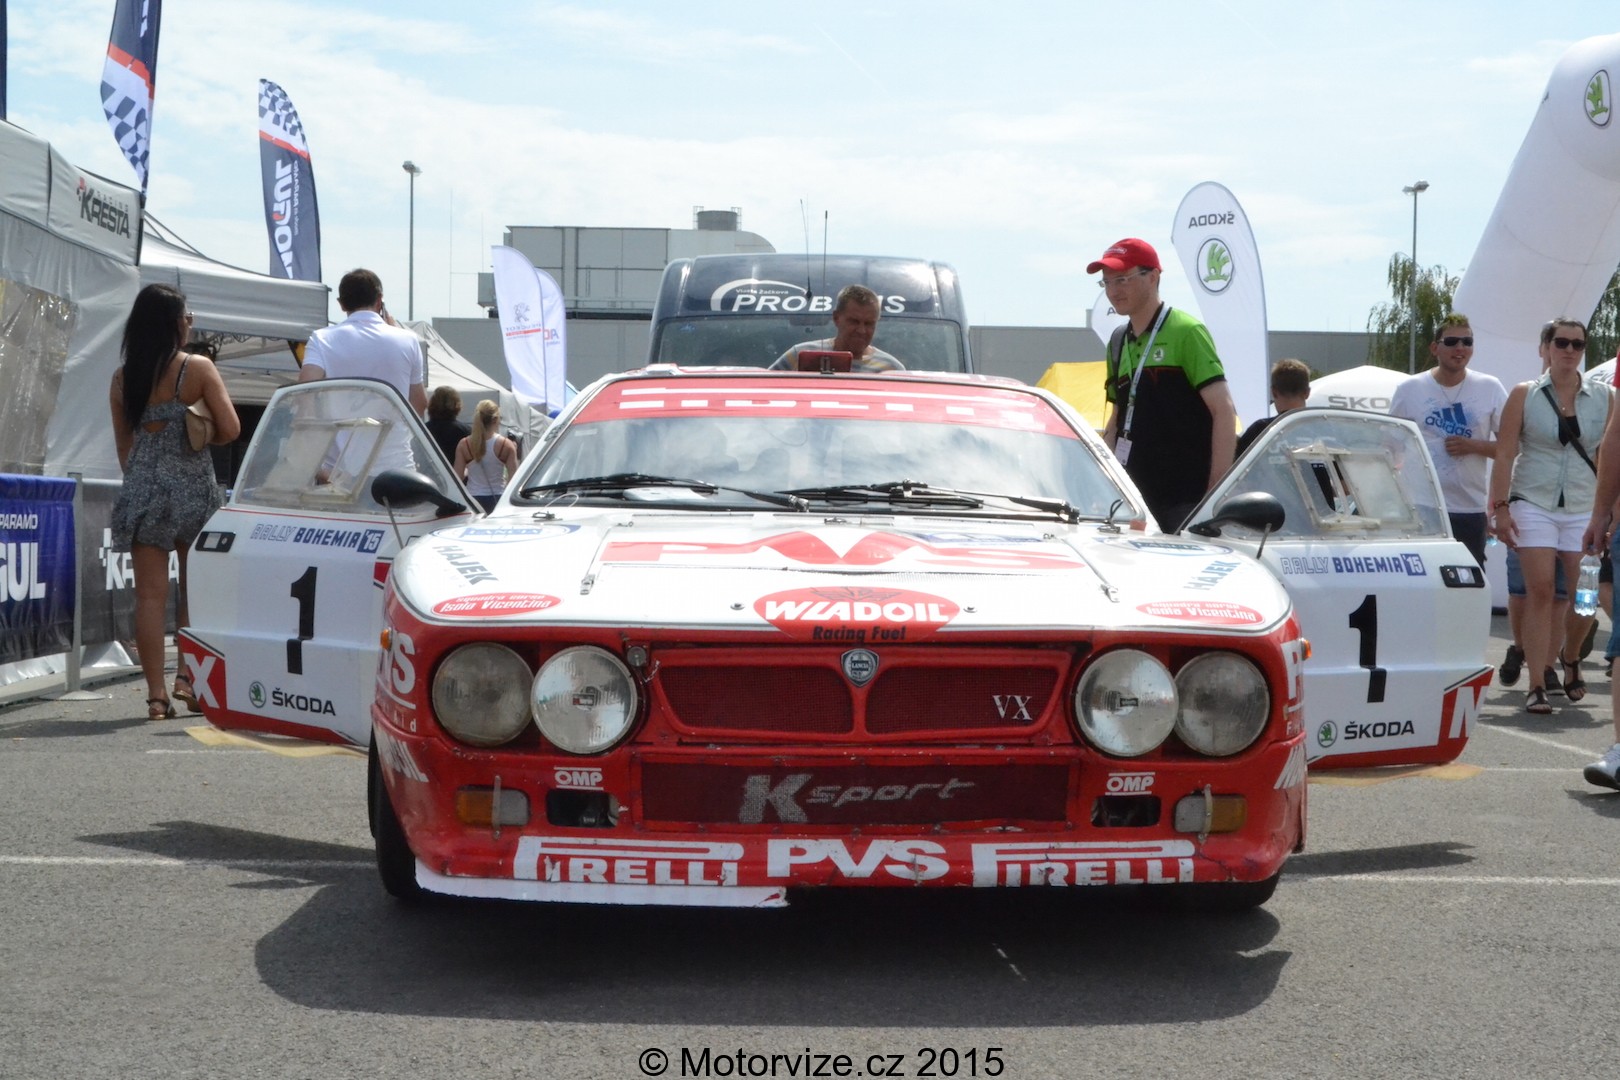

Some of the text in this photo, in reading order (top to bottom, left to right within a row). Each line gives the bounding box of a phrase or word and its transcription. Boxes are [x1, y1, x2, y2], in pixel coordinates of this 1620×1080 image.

[80, 188, 131, 239] KRESTA
[732, 295, 907, 314] PROBS
[1424, 414, 1473, 439] adidas
[250, 523, 296, 543] RALLY
[293, 527, 362, 549] BOHEMIA
[1280, 557, 1329, 575] RALLY
[1332, 556, 1404, 574] BOHEMIA
[440, 602, 476, 613] Isola
[1145, 606, 1182, 616] Isola
[286, 566, 318, 676] 1
[812, 625, 907, 643] Racing Fuel
[1348, 594, 1388, 703] 1
[271, 687, 337, 717] ŠKODA
[992, 694, 1034, 721] VX
[1344, 720, 1415, 740] ŠKODA
[555, 770, 603, 787] OMP
[1106, 775, 1154, 792] OMP
[513, 835, 1196, 888] PIRELLI PVS PIRELLI
